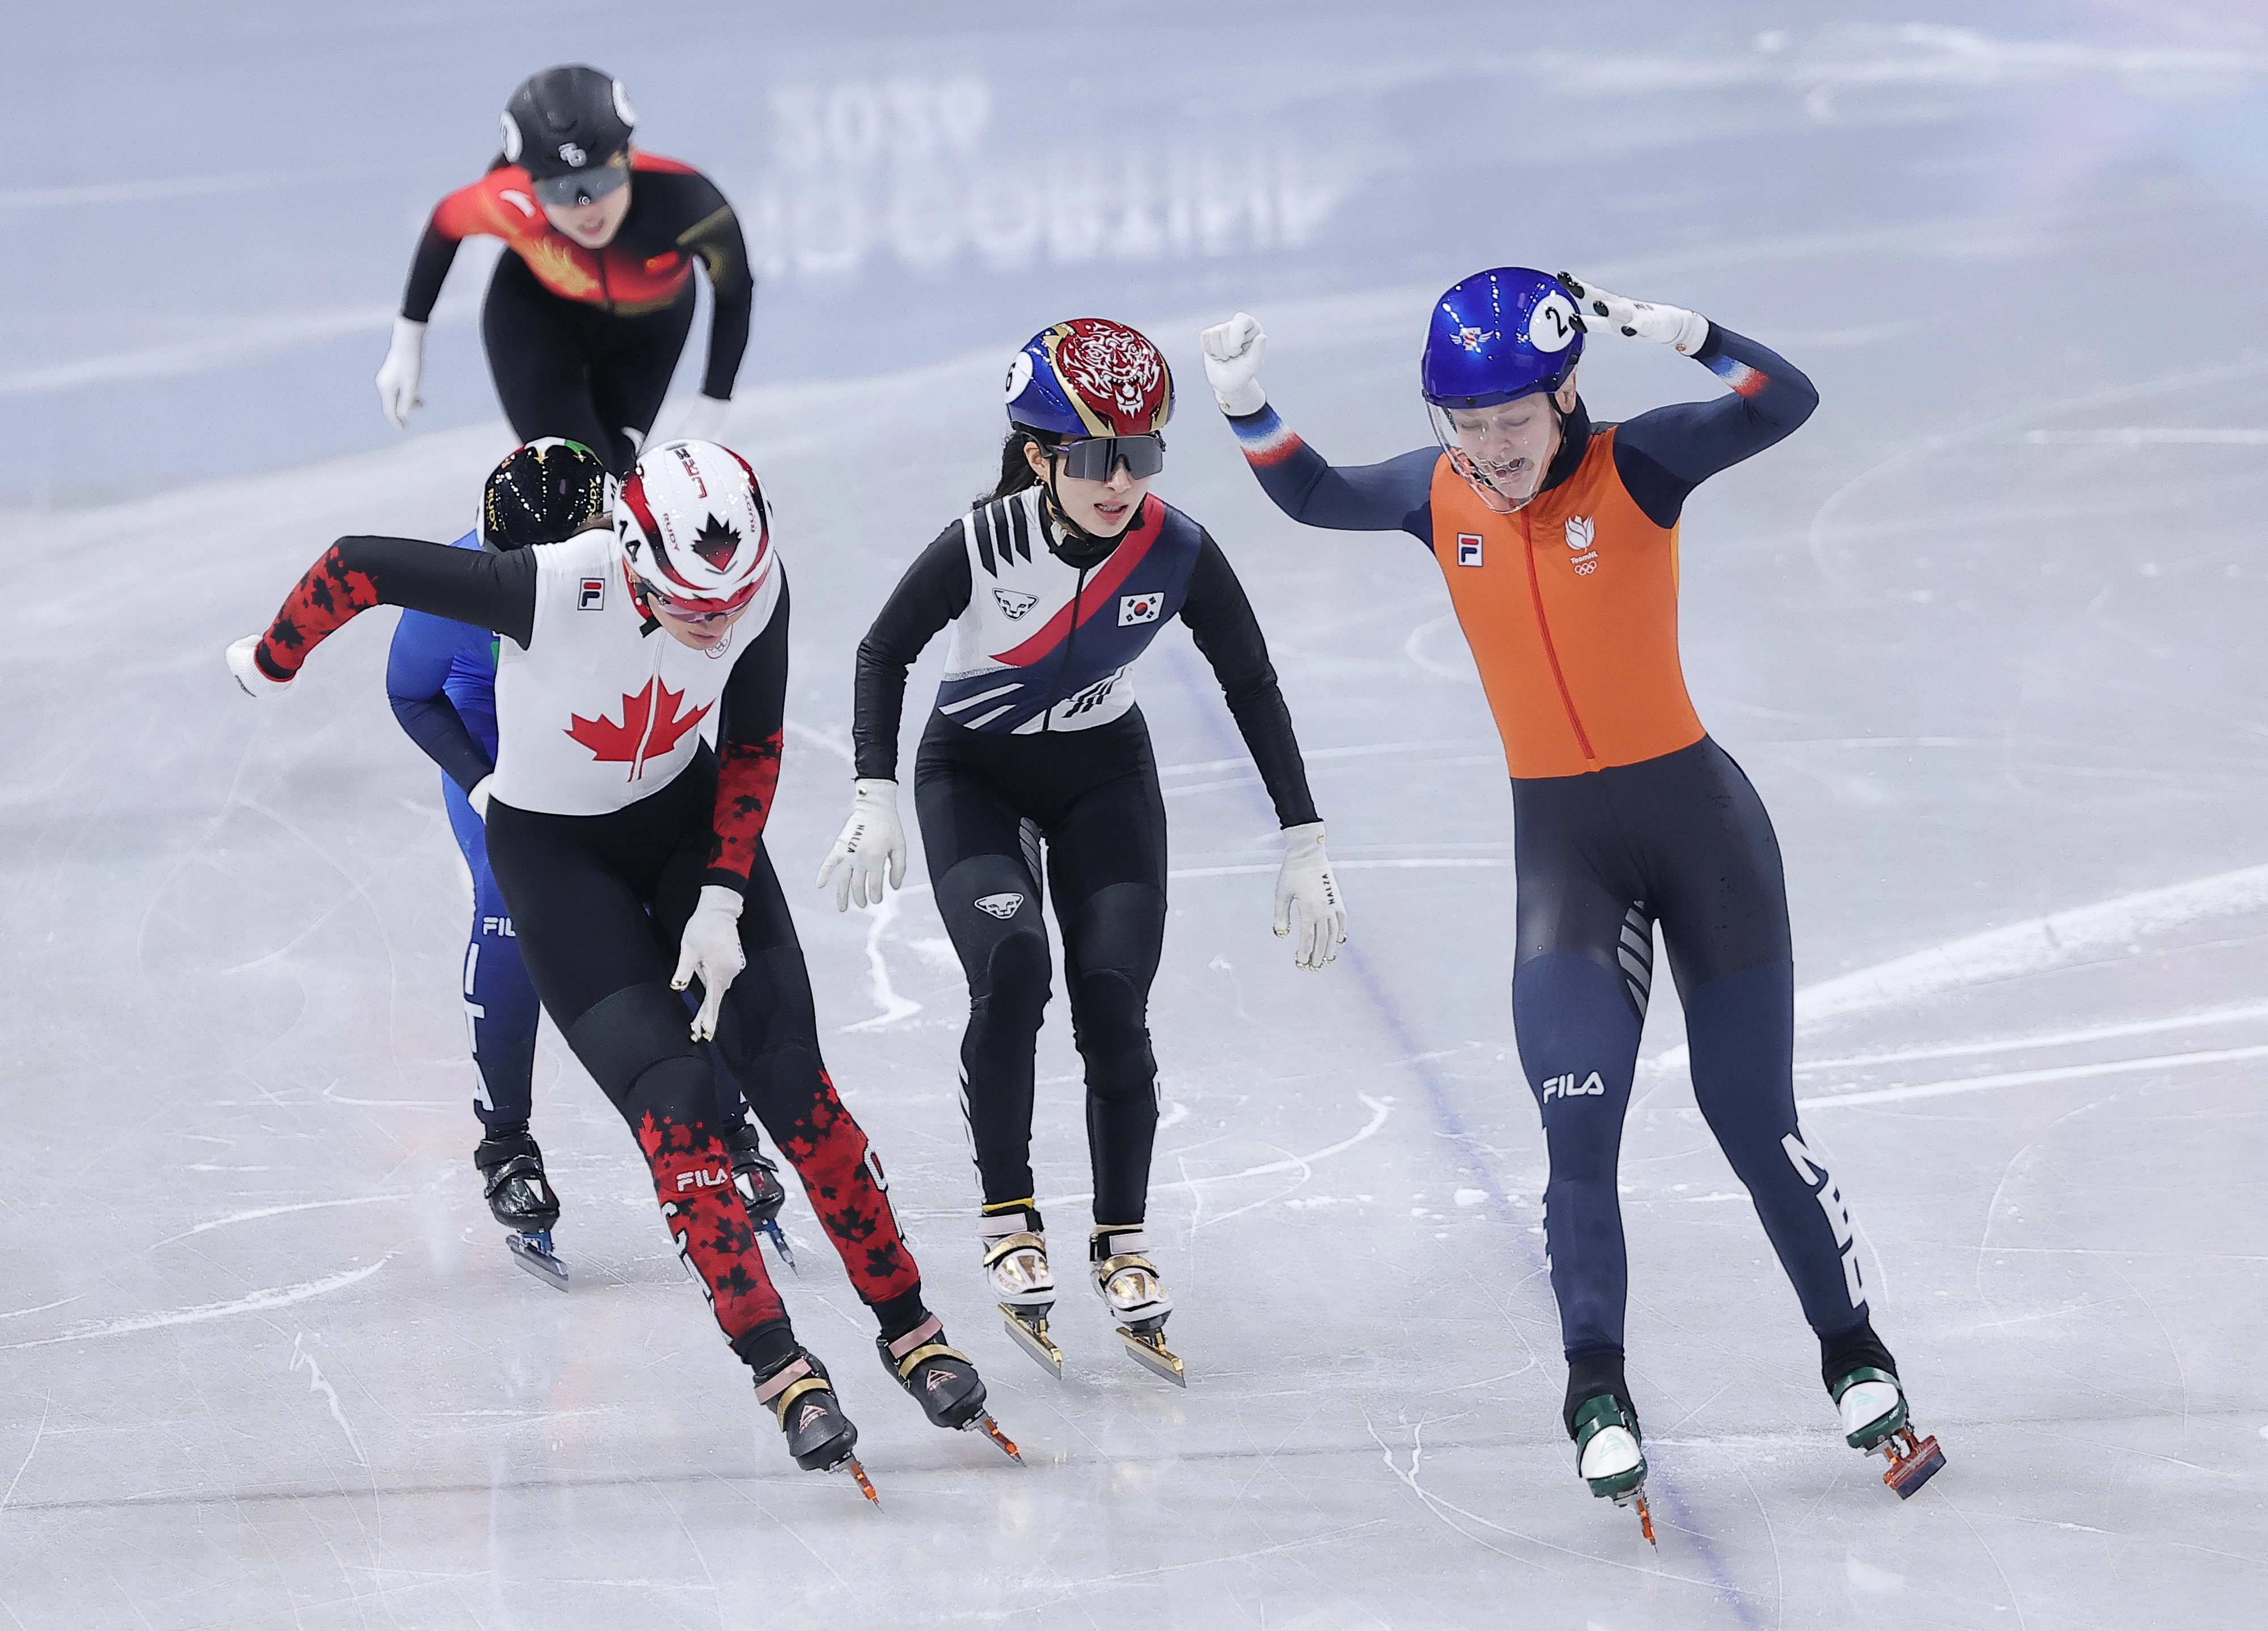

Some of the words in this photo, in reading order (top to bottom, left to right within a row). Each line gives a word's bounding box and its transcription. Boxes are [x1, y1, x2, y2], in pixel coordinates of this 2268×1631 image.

[1545, 307, 1568, 339] 2
[1005, 362, 1016, 392] 6
[488, 487, 499, 531] RUDY
[743, 493, 755, 533] RUDY
[663, 513, 680, 552] RUDY
[1569, 551, 1598, 565] TeamNL
[482, 916, 517, 936] FIL
[1542, 1071, 1606, 1104] FILA
[676, 1168, 729, 1191] FILA
